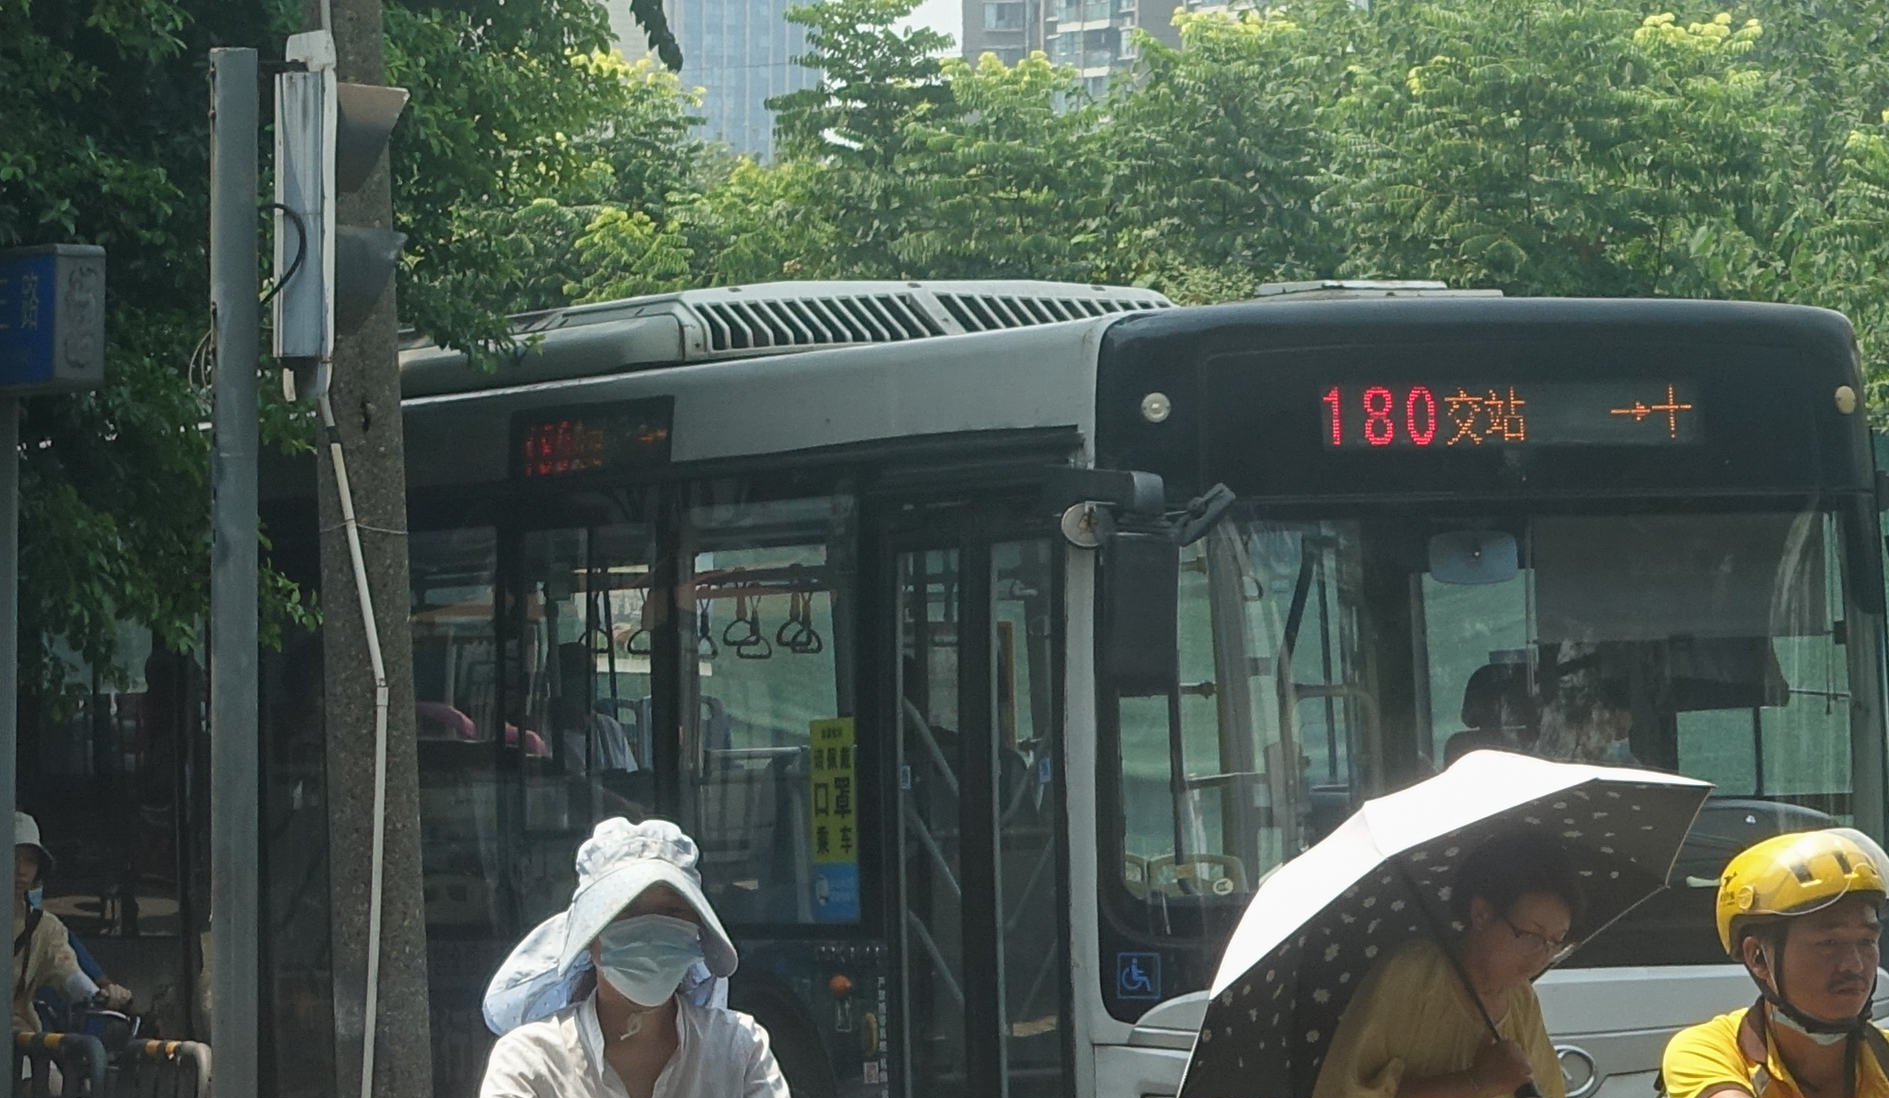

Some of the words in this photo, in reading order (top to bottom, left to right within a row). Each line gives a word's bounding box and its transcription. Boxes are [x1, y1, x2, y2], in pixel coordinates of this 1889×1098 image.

[1322, 386, 1436, 445] 180
[1443, 386, 1526, 445] 交站
[814, 776, 852, 819] 口罩
